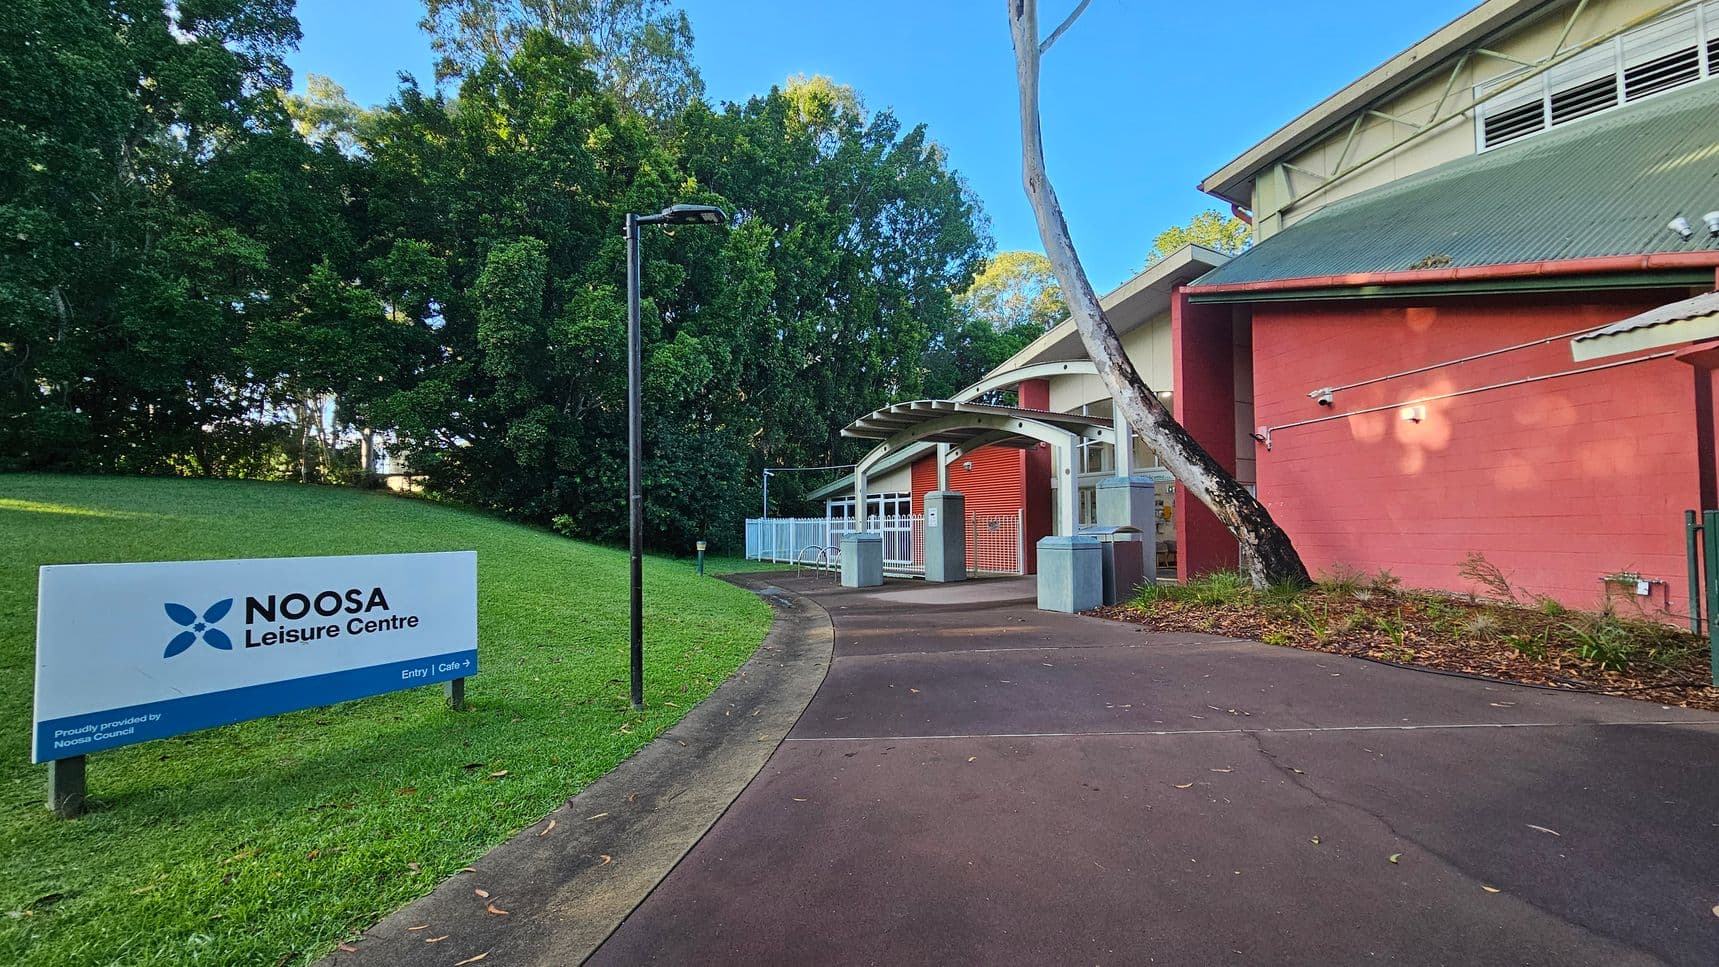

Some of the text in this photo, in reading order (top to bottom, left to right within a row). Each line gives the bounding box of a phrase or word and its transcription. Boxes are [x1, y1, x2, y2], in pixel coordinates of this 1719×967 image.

[246, 587, 390, 625] NOOSA
[245, 614, 419, 648] Leisure Centre
[401, 668, 428, 679] Entry
[438, 661, 460, 672] Cafe
[54, 713, 162, 738] Proudly provided by
[54, 726, 135, 749] Noosa Council
